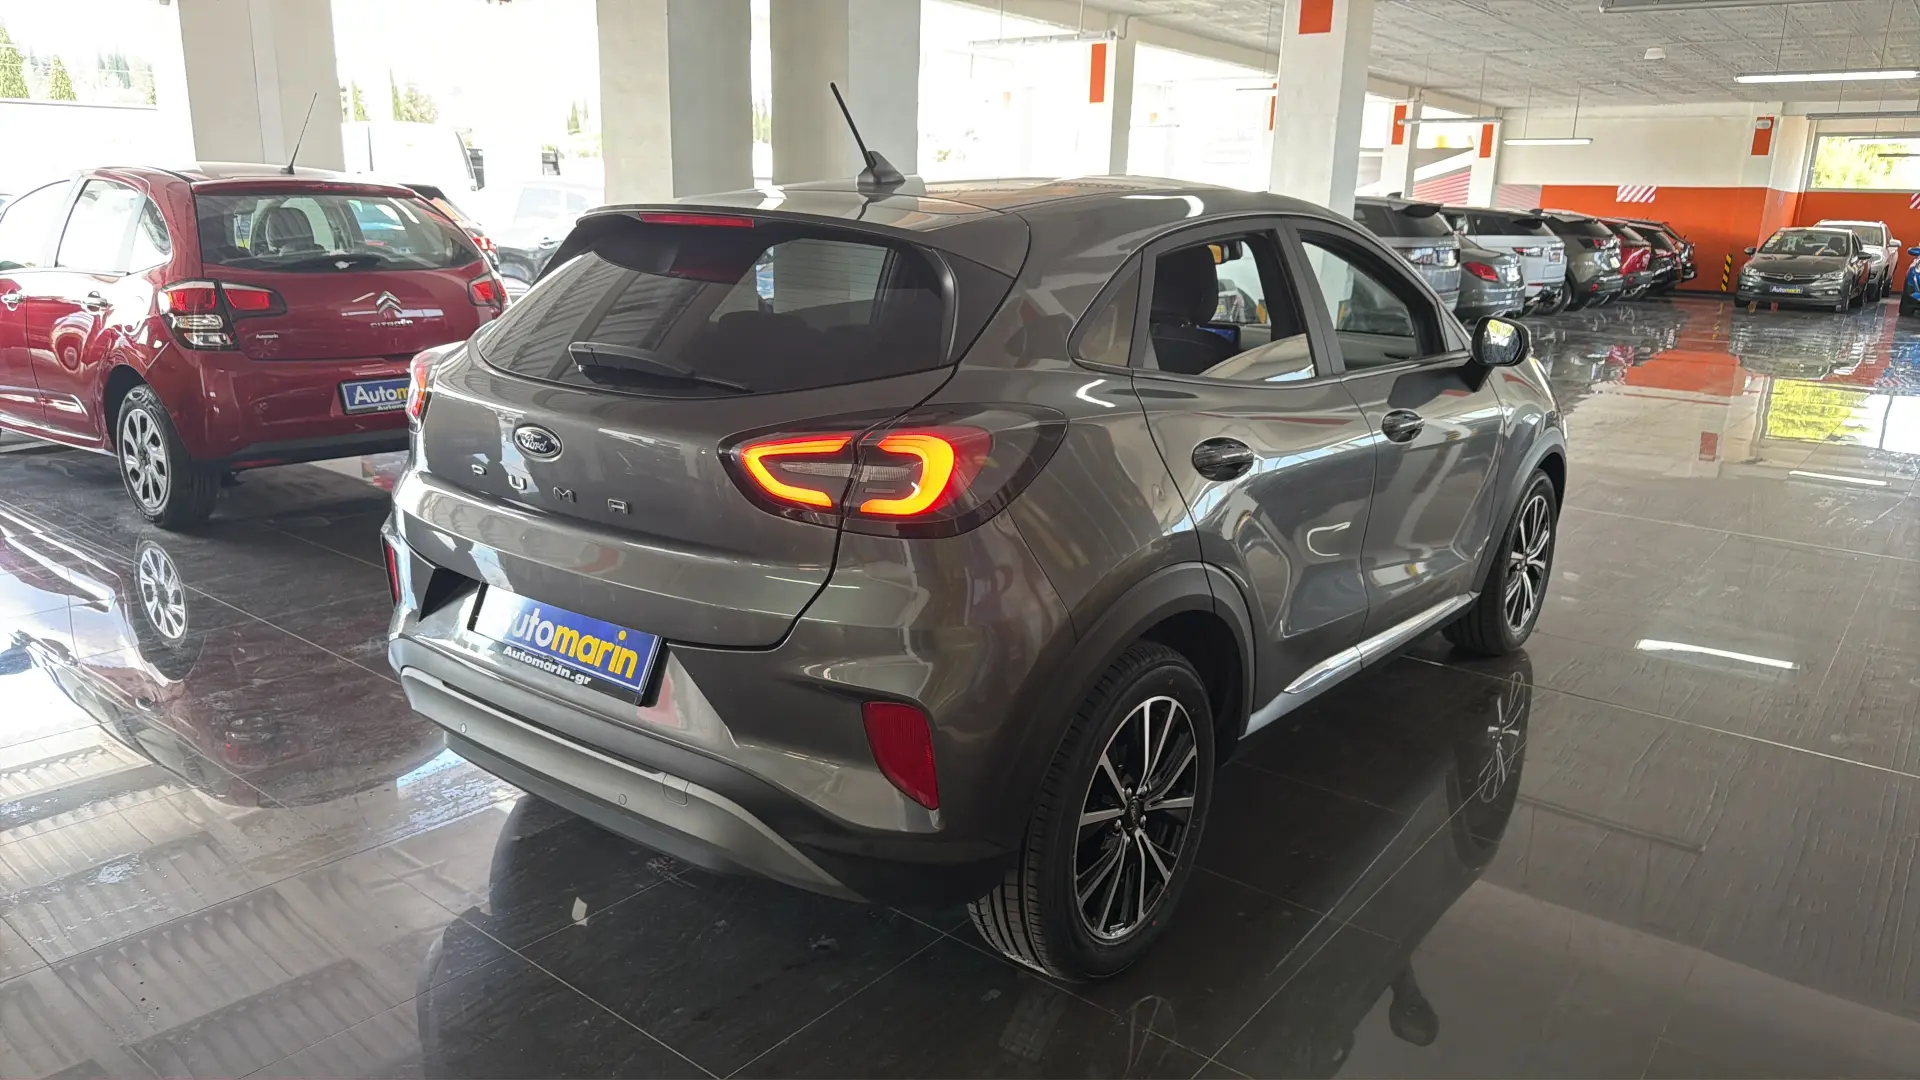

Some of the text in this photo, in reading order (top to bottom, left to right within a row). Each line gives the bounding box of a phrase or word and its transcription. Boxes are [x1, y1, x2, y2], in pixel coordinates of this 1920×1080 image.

[354, 385, 408, 404] Autom
[518, 430, 548, 452] Ford
[471, 464, 630, 515] PUMA
[511, 607, 638, 679] utomarin
[503, 646, 592, 685] Automarin.gr
